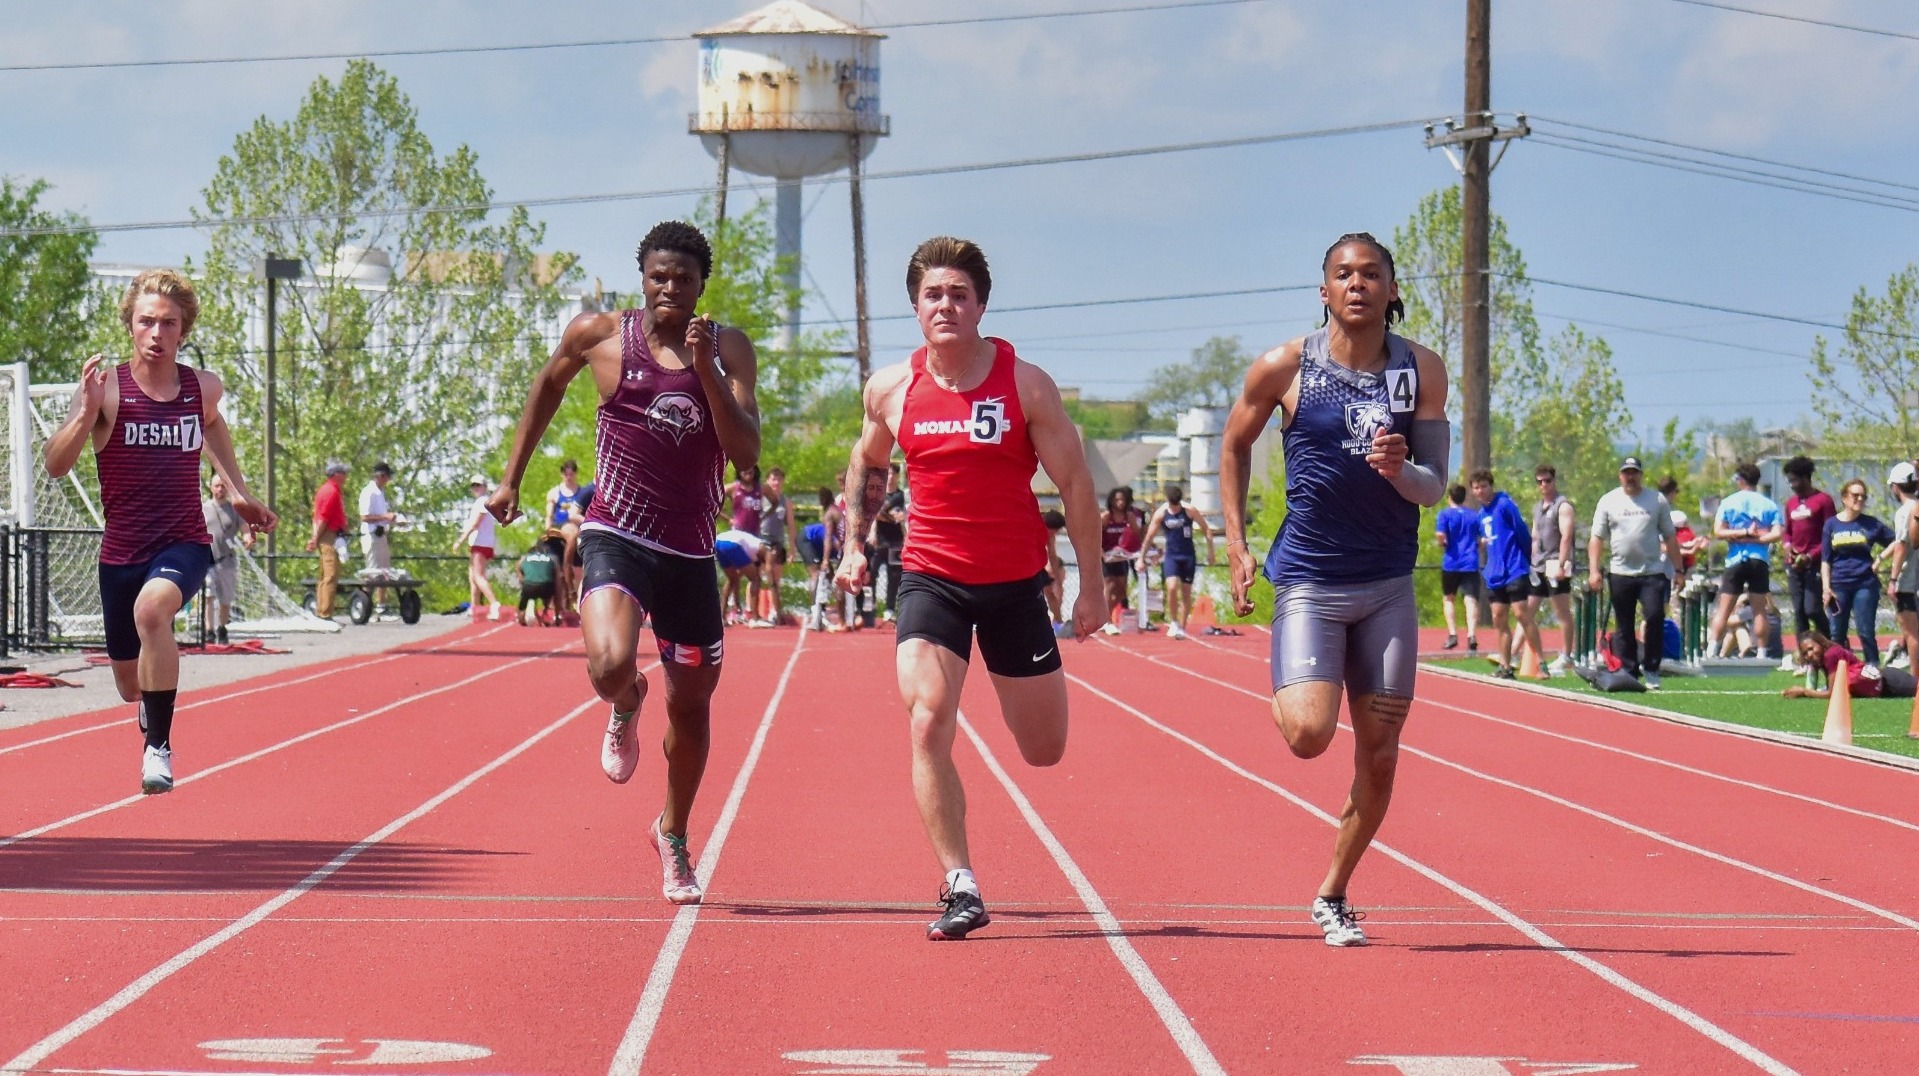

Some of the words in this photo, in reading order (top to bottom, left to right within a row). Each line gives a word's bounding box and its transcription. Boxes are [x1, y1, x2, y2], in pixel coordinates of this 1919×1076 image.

[1393, 371, 1413, 409] 4
[124, 422, 182, 446] DESAL
[182, 416, 197, 449] 7
[974, 404, 997, 440] 5
